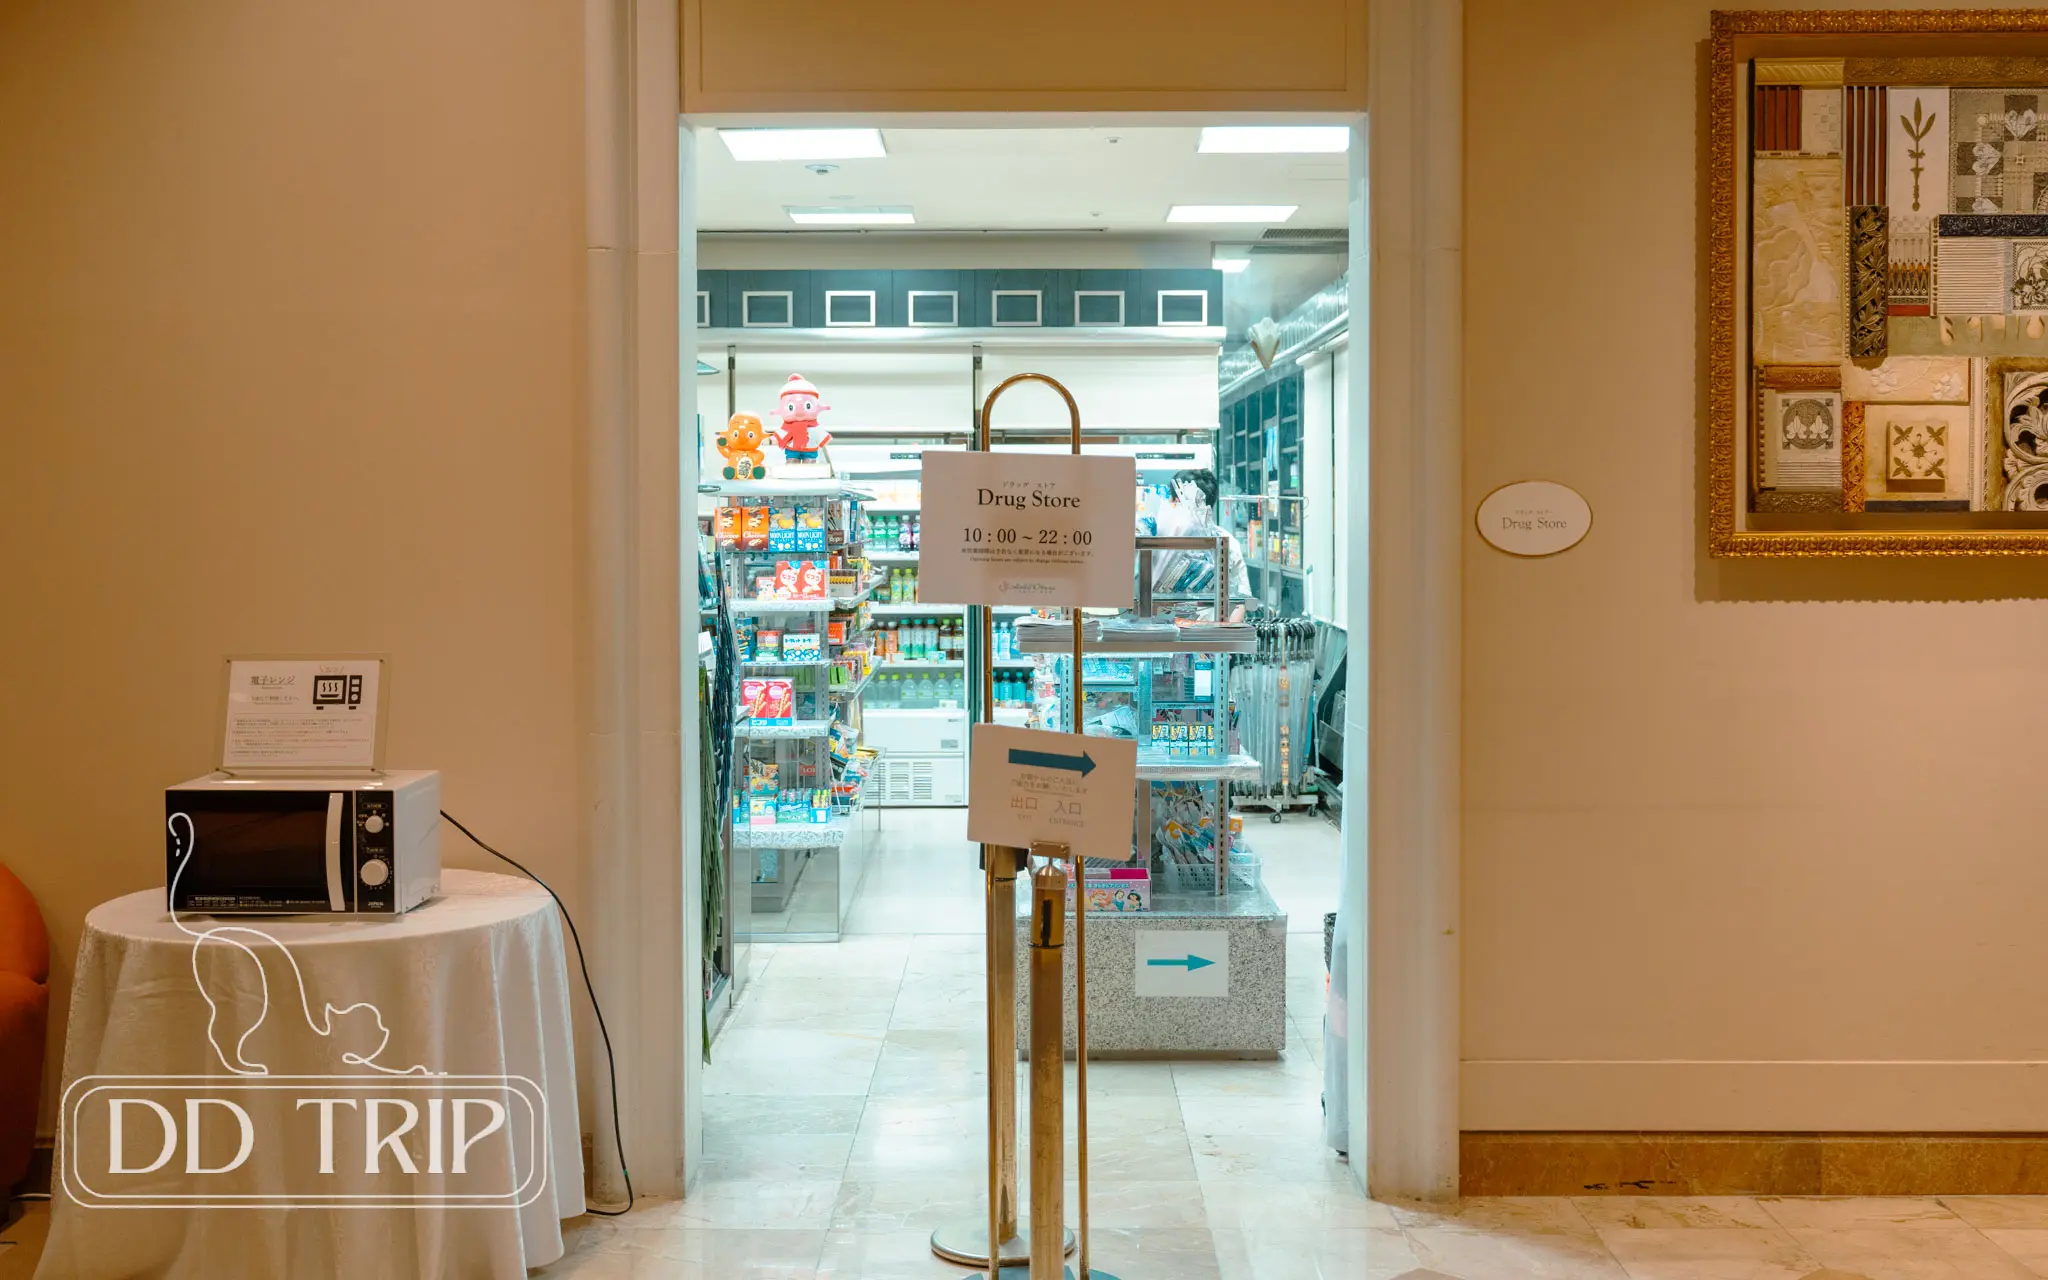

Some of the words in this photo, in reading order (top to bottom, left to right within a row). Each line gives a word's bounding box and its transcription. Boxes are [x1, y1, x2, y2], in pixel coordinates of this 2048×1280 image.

[977, 488, 1026, 510] Drug
[1032, 490, 1081, 508] Store
[1502, 517, 1532, 531] Drug
[1537, 517, 1567, 529] Store
[250, 674, 296, 686] 電子レンジ
[1010, 794, 1038, 810] 出口
[1054, 800, 1082, 815] 入口
[1049, 816, 1085, 828] ENTRANCE
